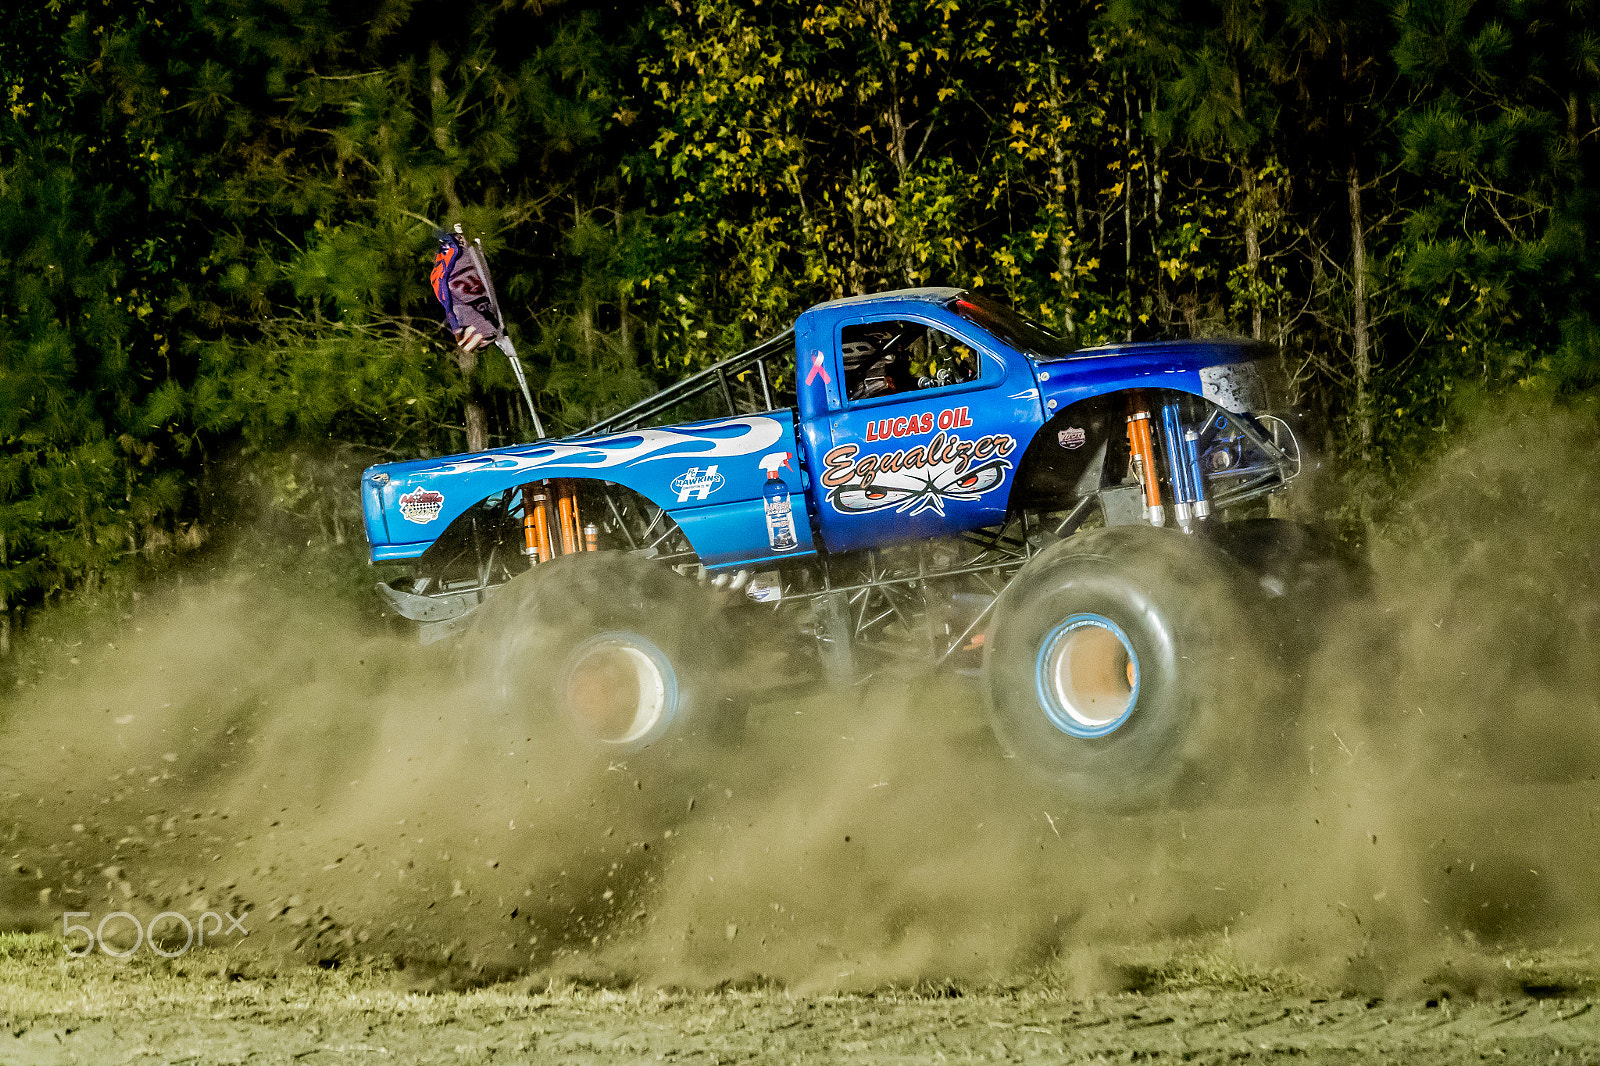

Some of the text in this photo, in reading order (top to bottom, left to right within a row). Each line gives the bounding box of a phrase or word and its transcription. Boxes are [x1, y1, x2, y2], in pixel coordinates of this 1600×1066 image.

[866, 406, 973, 442] LUCAS OIL
[821, 433, 1016, 489] Equalizer
[675, 474, 720, 487] HAWKINS
